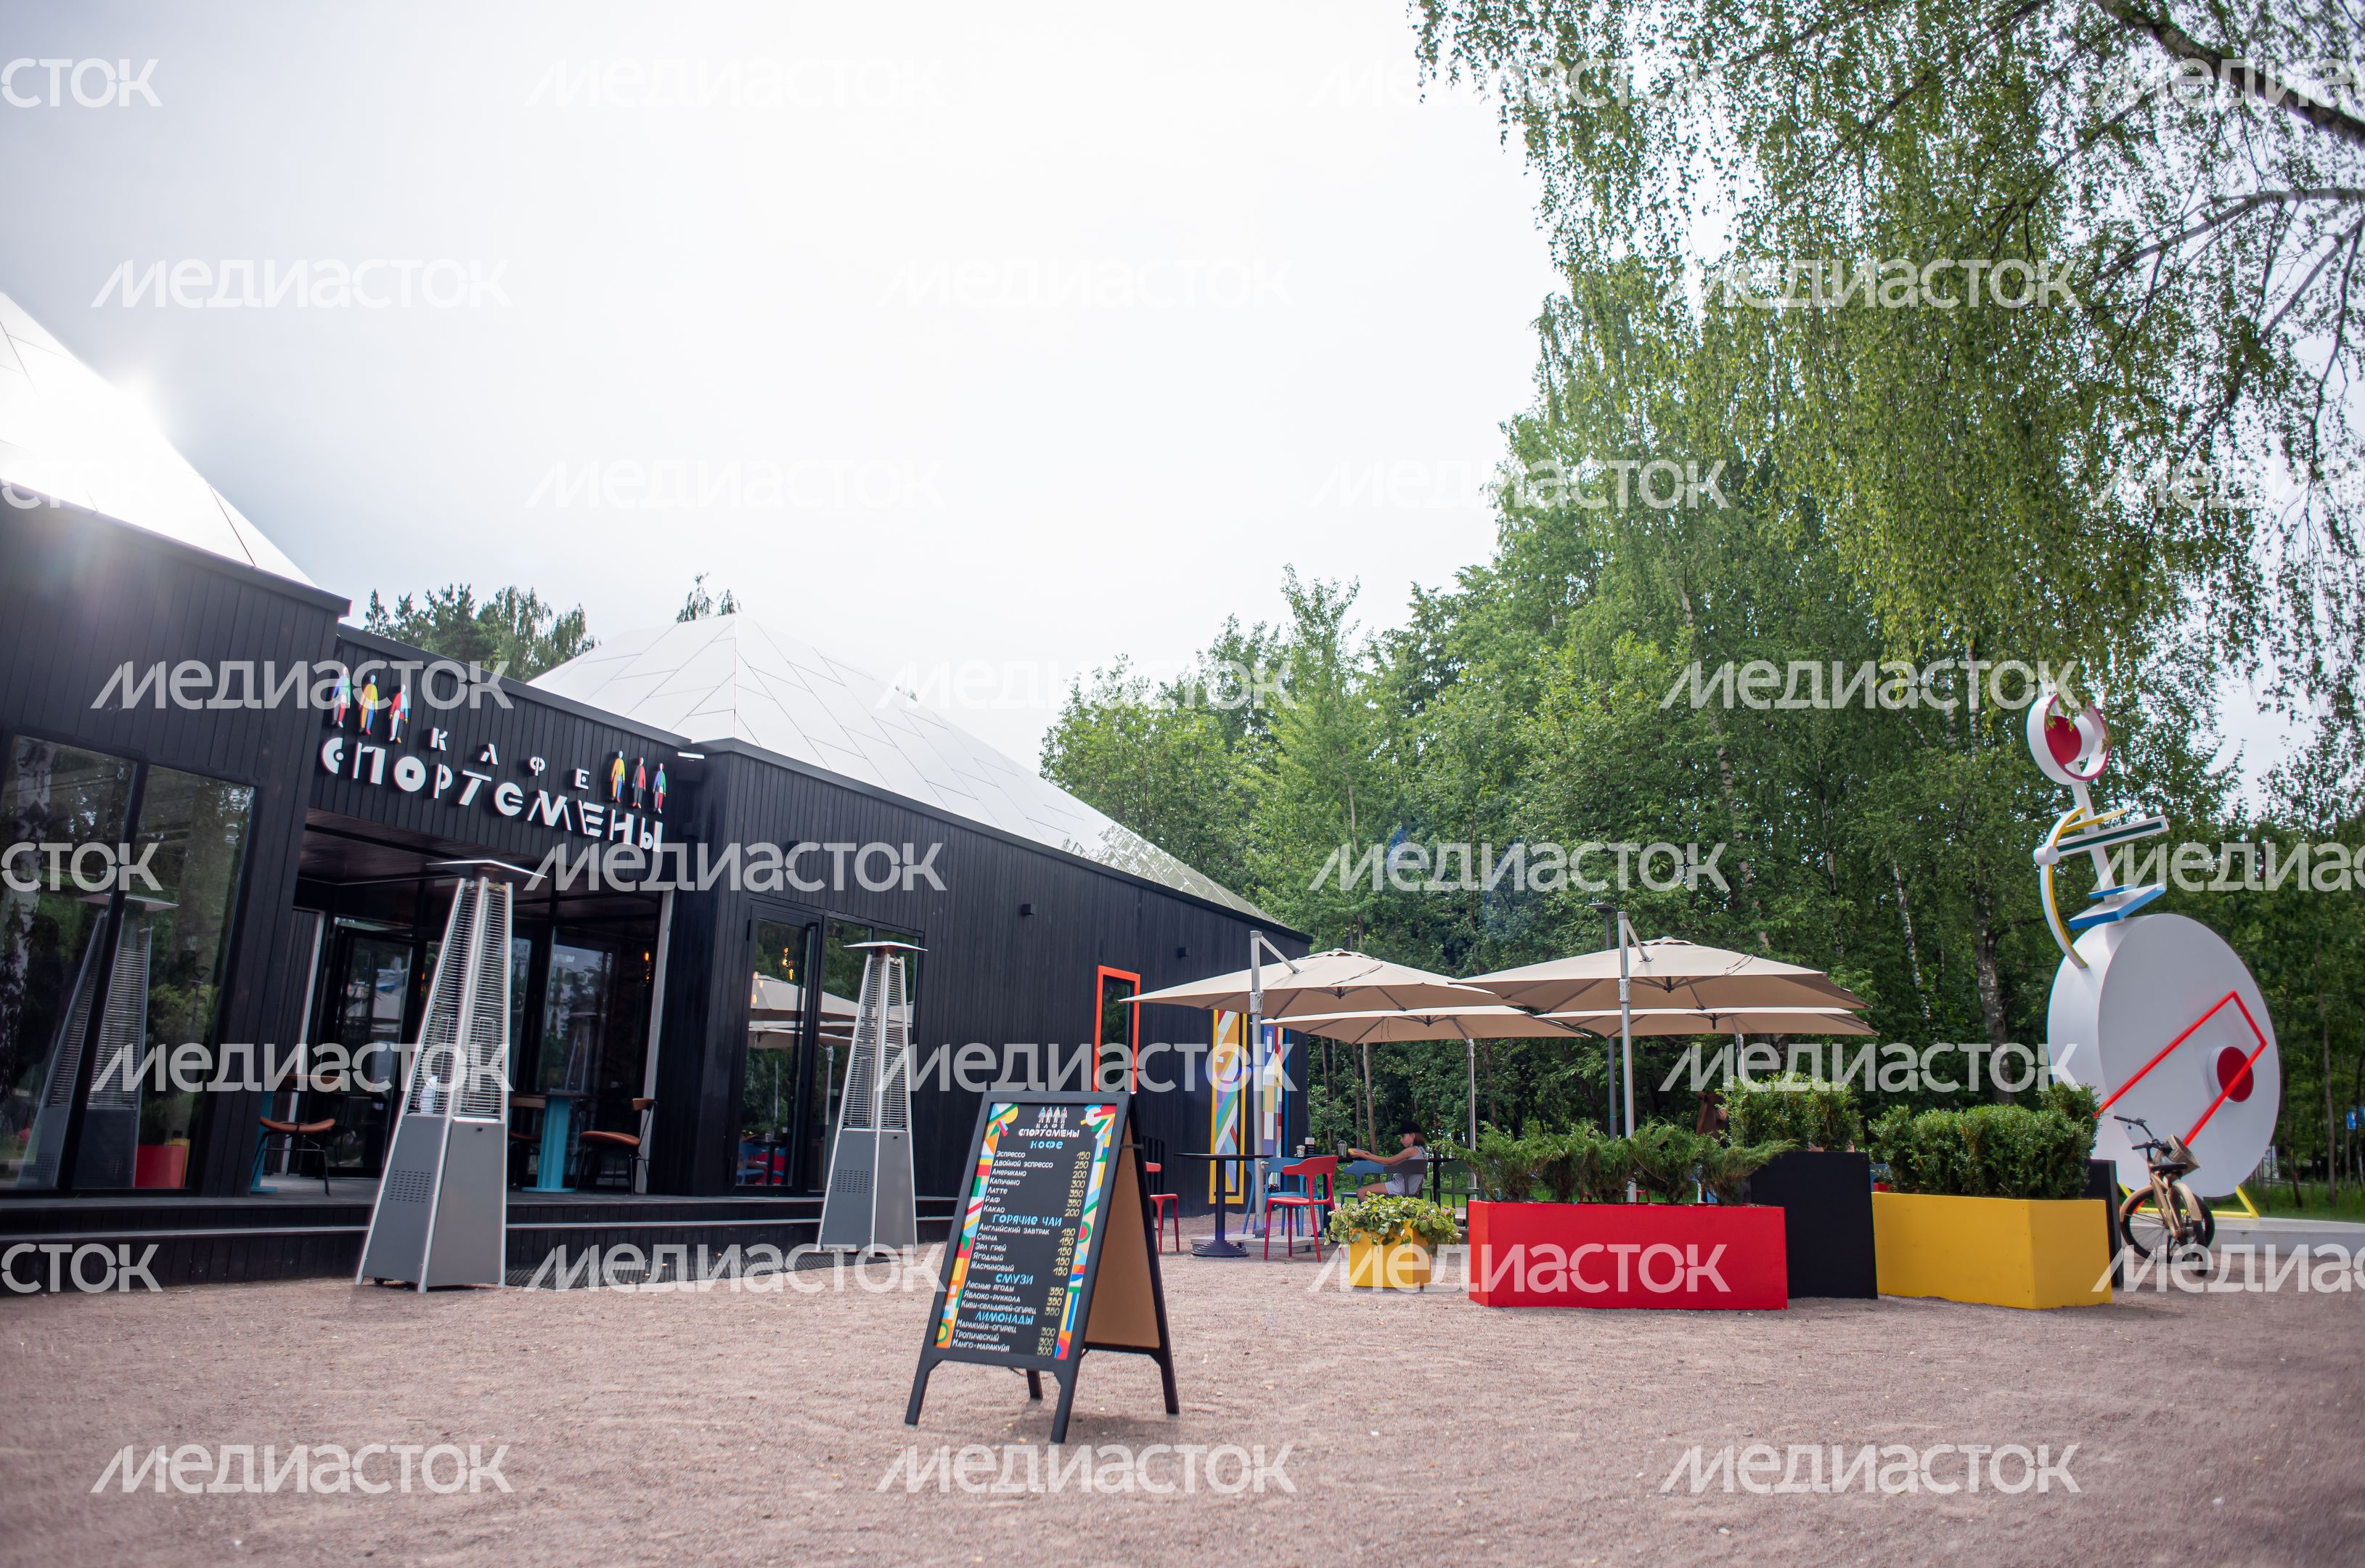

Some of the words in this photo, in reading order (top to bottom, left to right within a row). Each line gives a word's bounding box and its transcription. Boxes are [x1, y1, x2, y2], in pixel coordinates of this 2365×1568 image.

[430, 727, 589, 790] КАФЕ
[322, 737, 663, 853] СПОРТСМЕНЫ
[1077, 1151, 1090, 1160] 150
[1065, 1209, 1080, 1217] 200
[1061, 1228, 1076, 1237] 150
[1059, 1237, 1074, 1246] 150
[1058, 1247, 1072, 1256] 150
[1055, 1257, 1070, 1266] 150
[1053, 1267, 1069, 1276] 150
